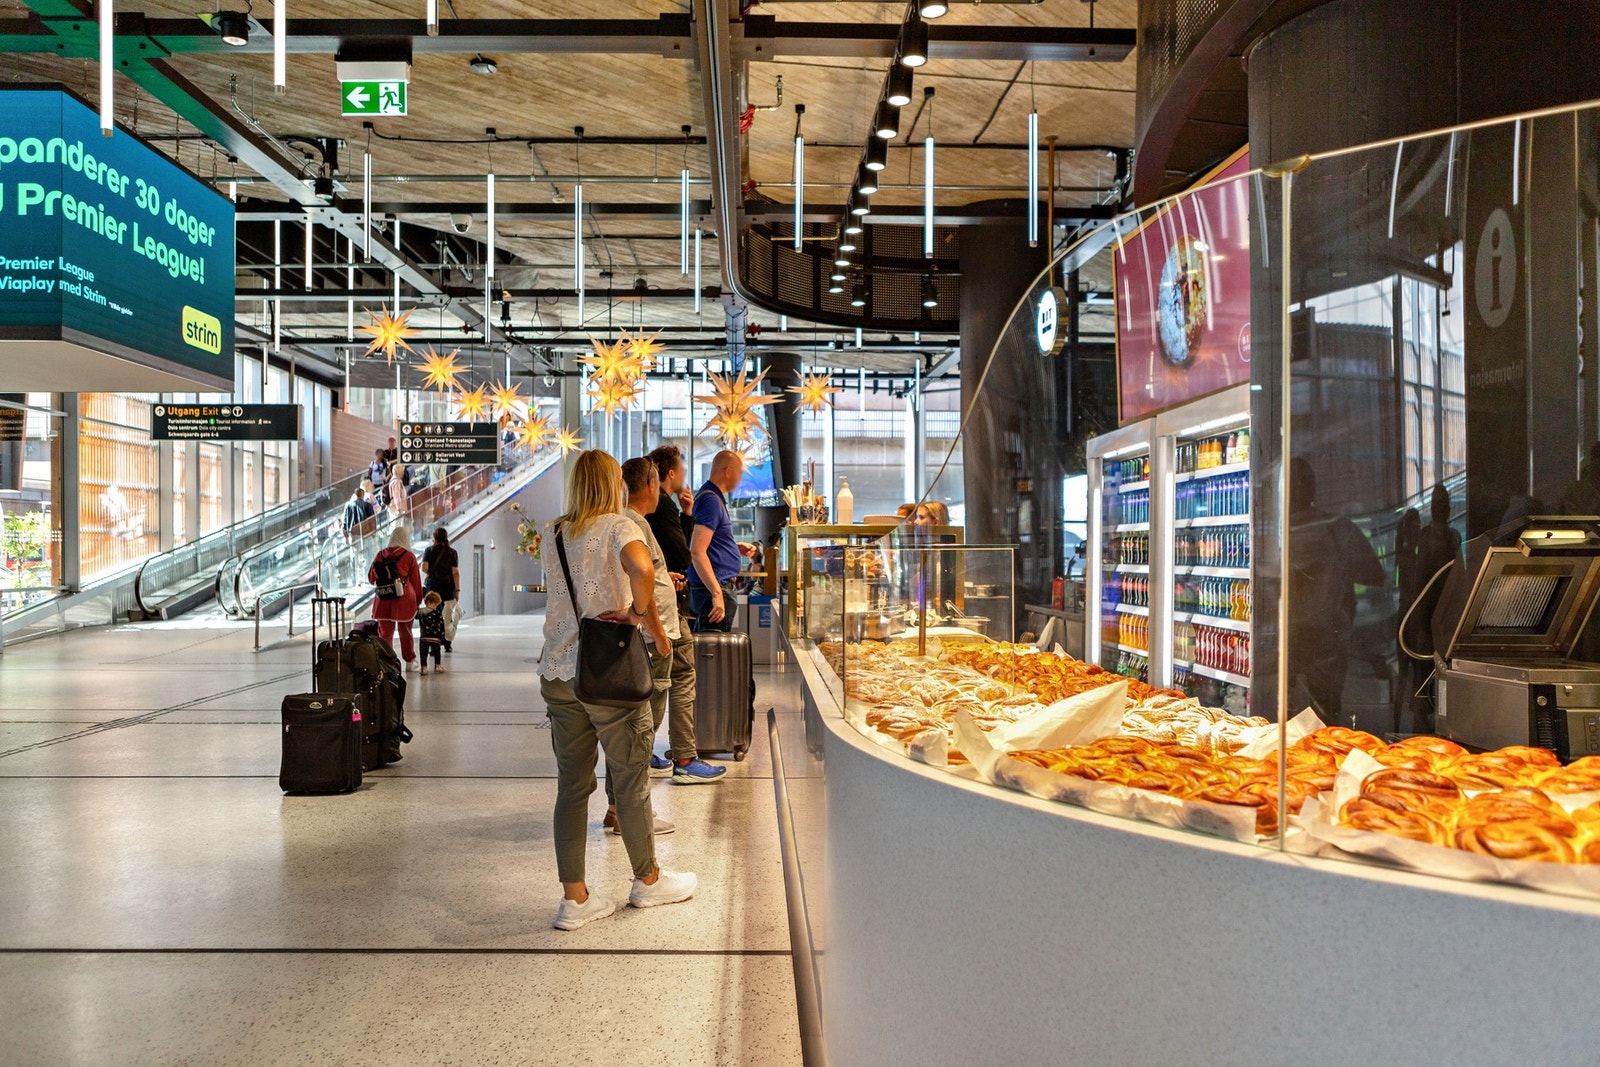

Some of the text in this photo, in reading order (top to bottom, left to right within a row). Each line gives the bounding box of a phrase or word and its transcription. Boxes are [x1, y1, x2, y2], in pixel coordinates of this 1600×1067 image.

[135, 178, 160, 216] 30
[164, 198, 216, 247] dager
[18, 183, 128, 245] Premier
[133, 222, 205, 285] League!
[0, 256, 95, 282] Premier League
[0, 275, 107, 306] Viaplay med Strim
[186, 319, 218, 348] strim
[167, 406, 219, 417] Utgang Exit
[414, 424, 422, 434] C
